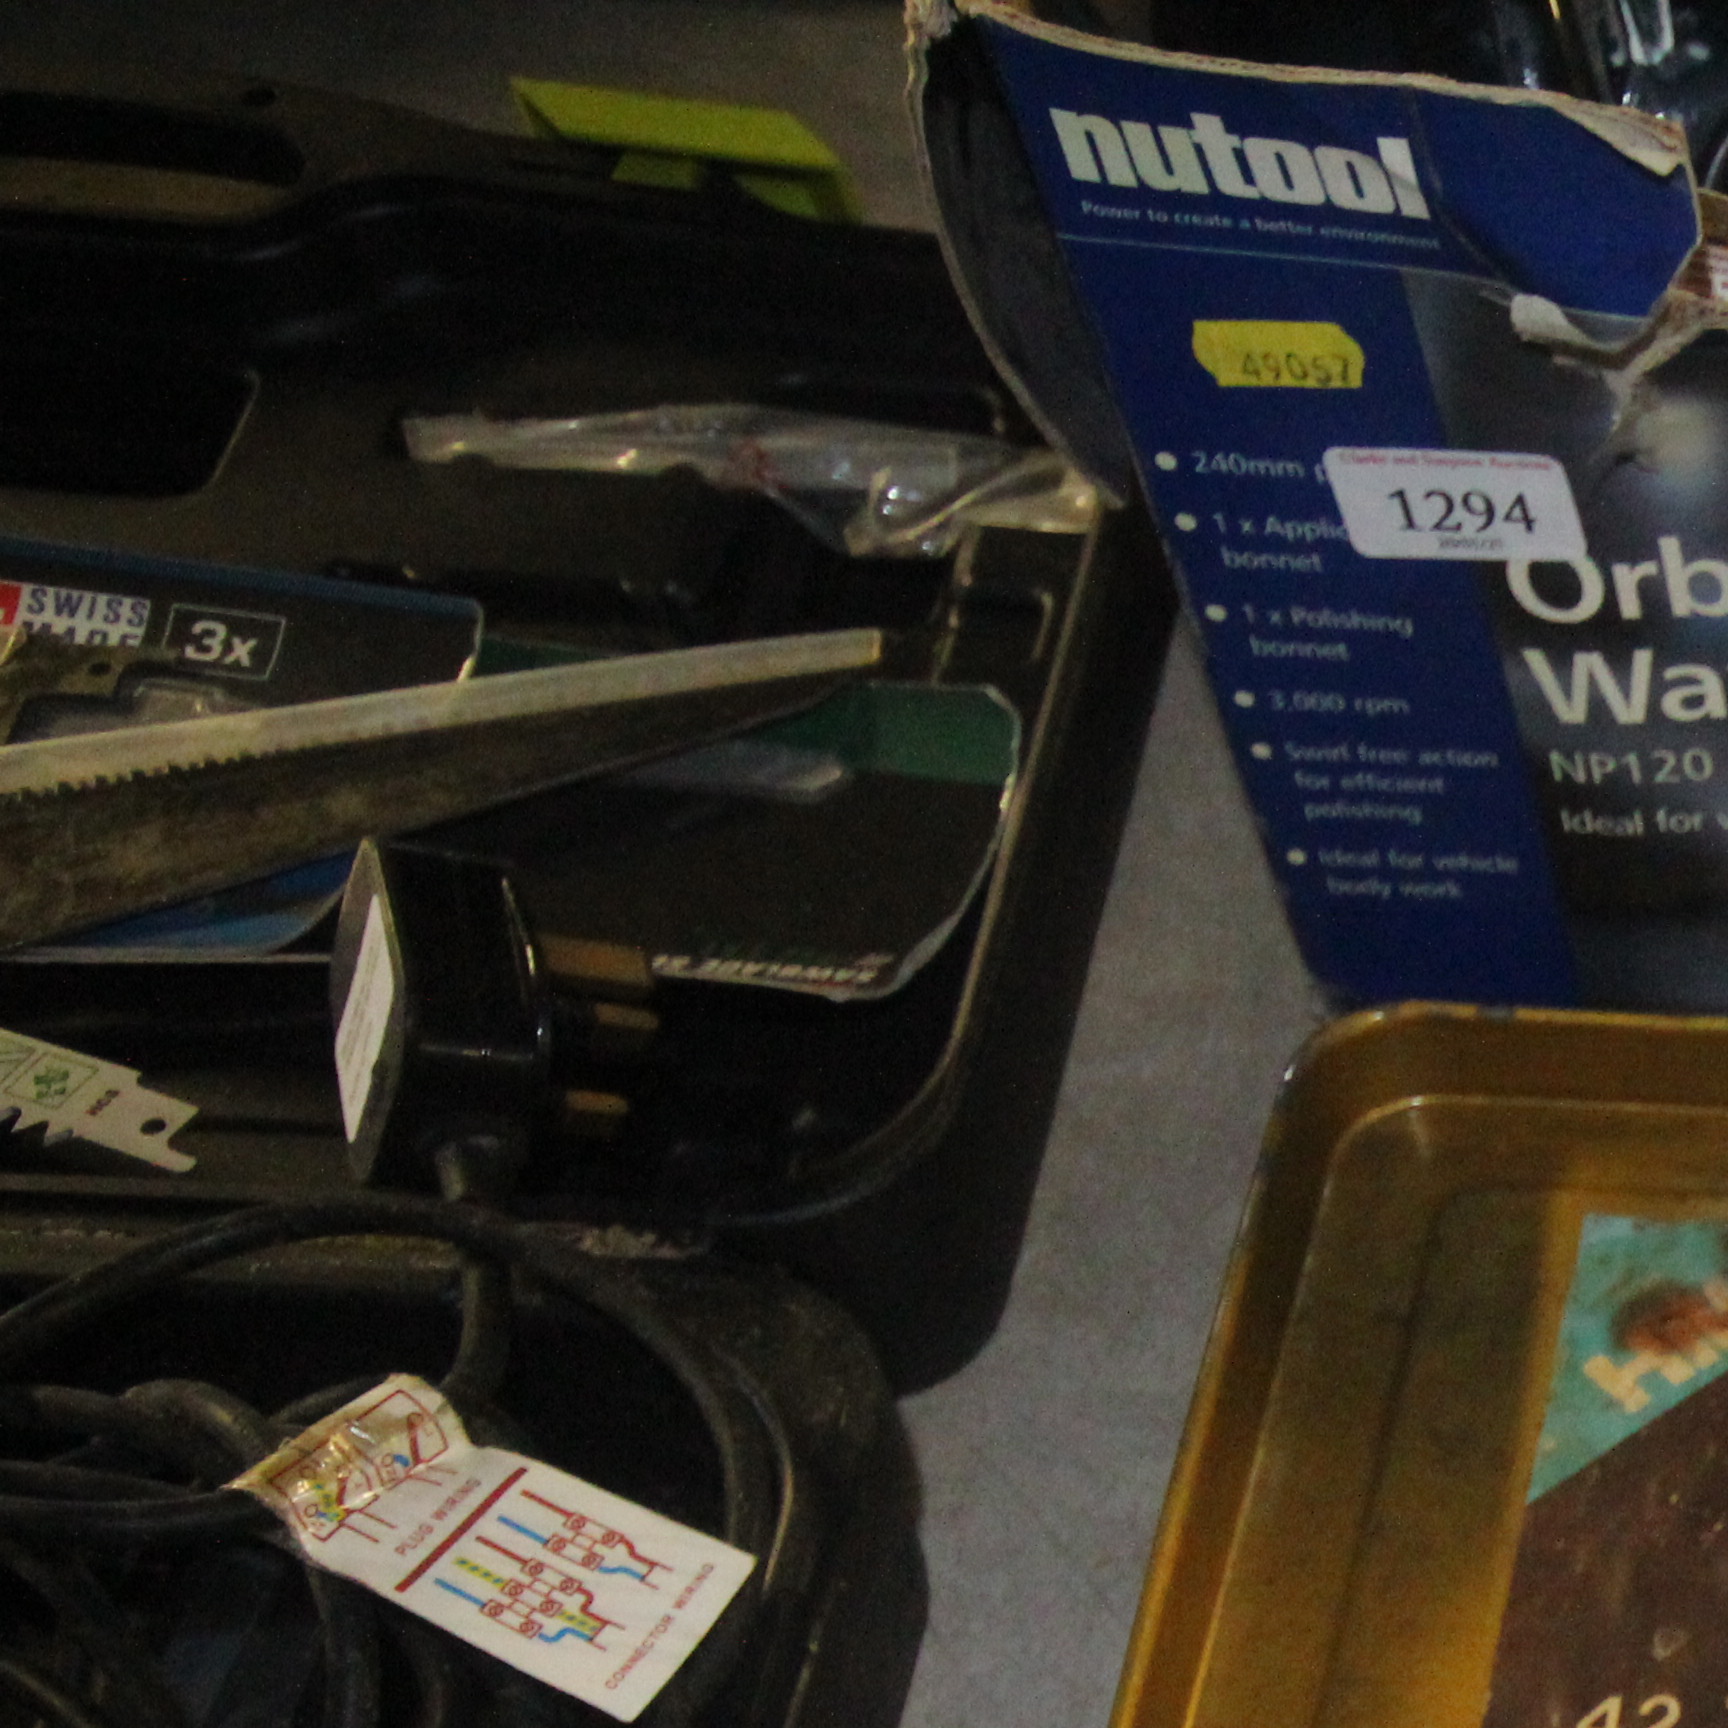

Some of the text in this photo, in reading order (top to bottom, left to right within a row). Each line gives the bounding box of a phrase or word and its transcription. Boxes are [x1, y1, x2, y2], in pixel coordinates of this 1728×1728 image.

[1049, 107, 1431, 220] nutool
[1081, 200, 1140, 220] Power
[1148, 208, 1168, 222] to
[1174, 212, 1232, 228] create
[1240, 217, 1250, 228] a
[1255, 216, 1313, 236] better
[1193, 451, 1305, 477] 240mm
[1239, 519, 1253, 536] x
[1387, 487, 1537, 534] 1294
[1221, 545, 1323, 572] bonnet
[27, 587, 148, 628] SWISS
[1290, 604, 1414, 638] Polishing
[184, 620, 259, 668] 3x
[1250, 634, 1349, 661] bonnet
[1548, 748, 1714, 785] NP120
[1560, 807, 1644, 837] Ideal
[1656, 808, 1704, 833] for
[394, 1478, 481, 1556] PLUG WIRING
[605, 1562, 716, 1690] CONNECTOR WIRING
